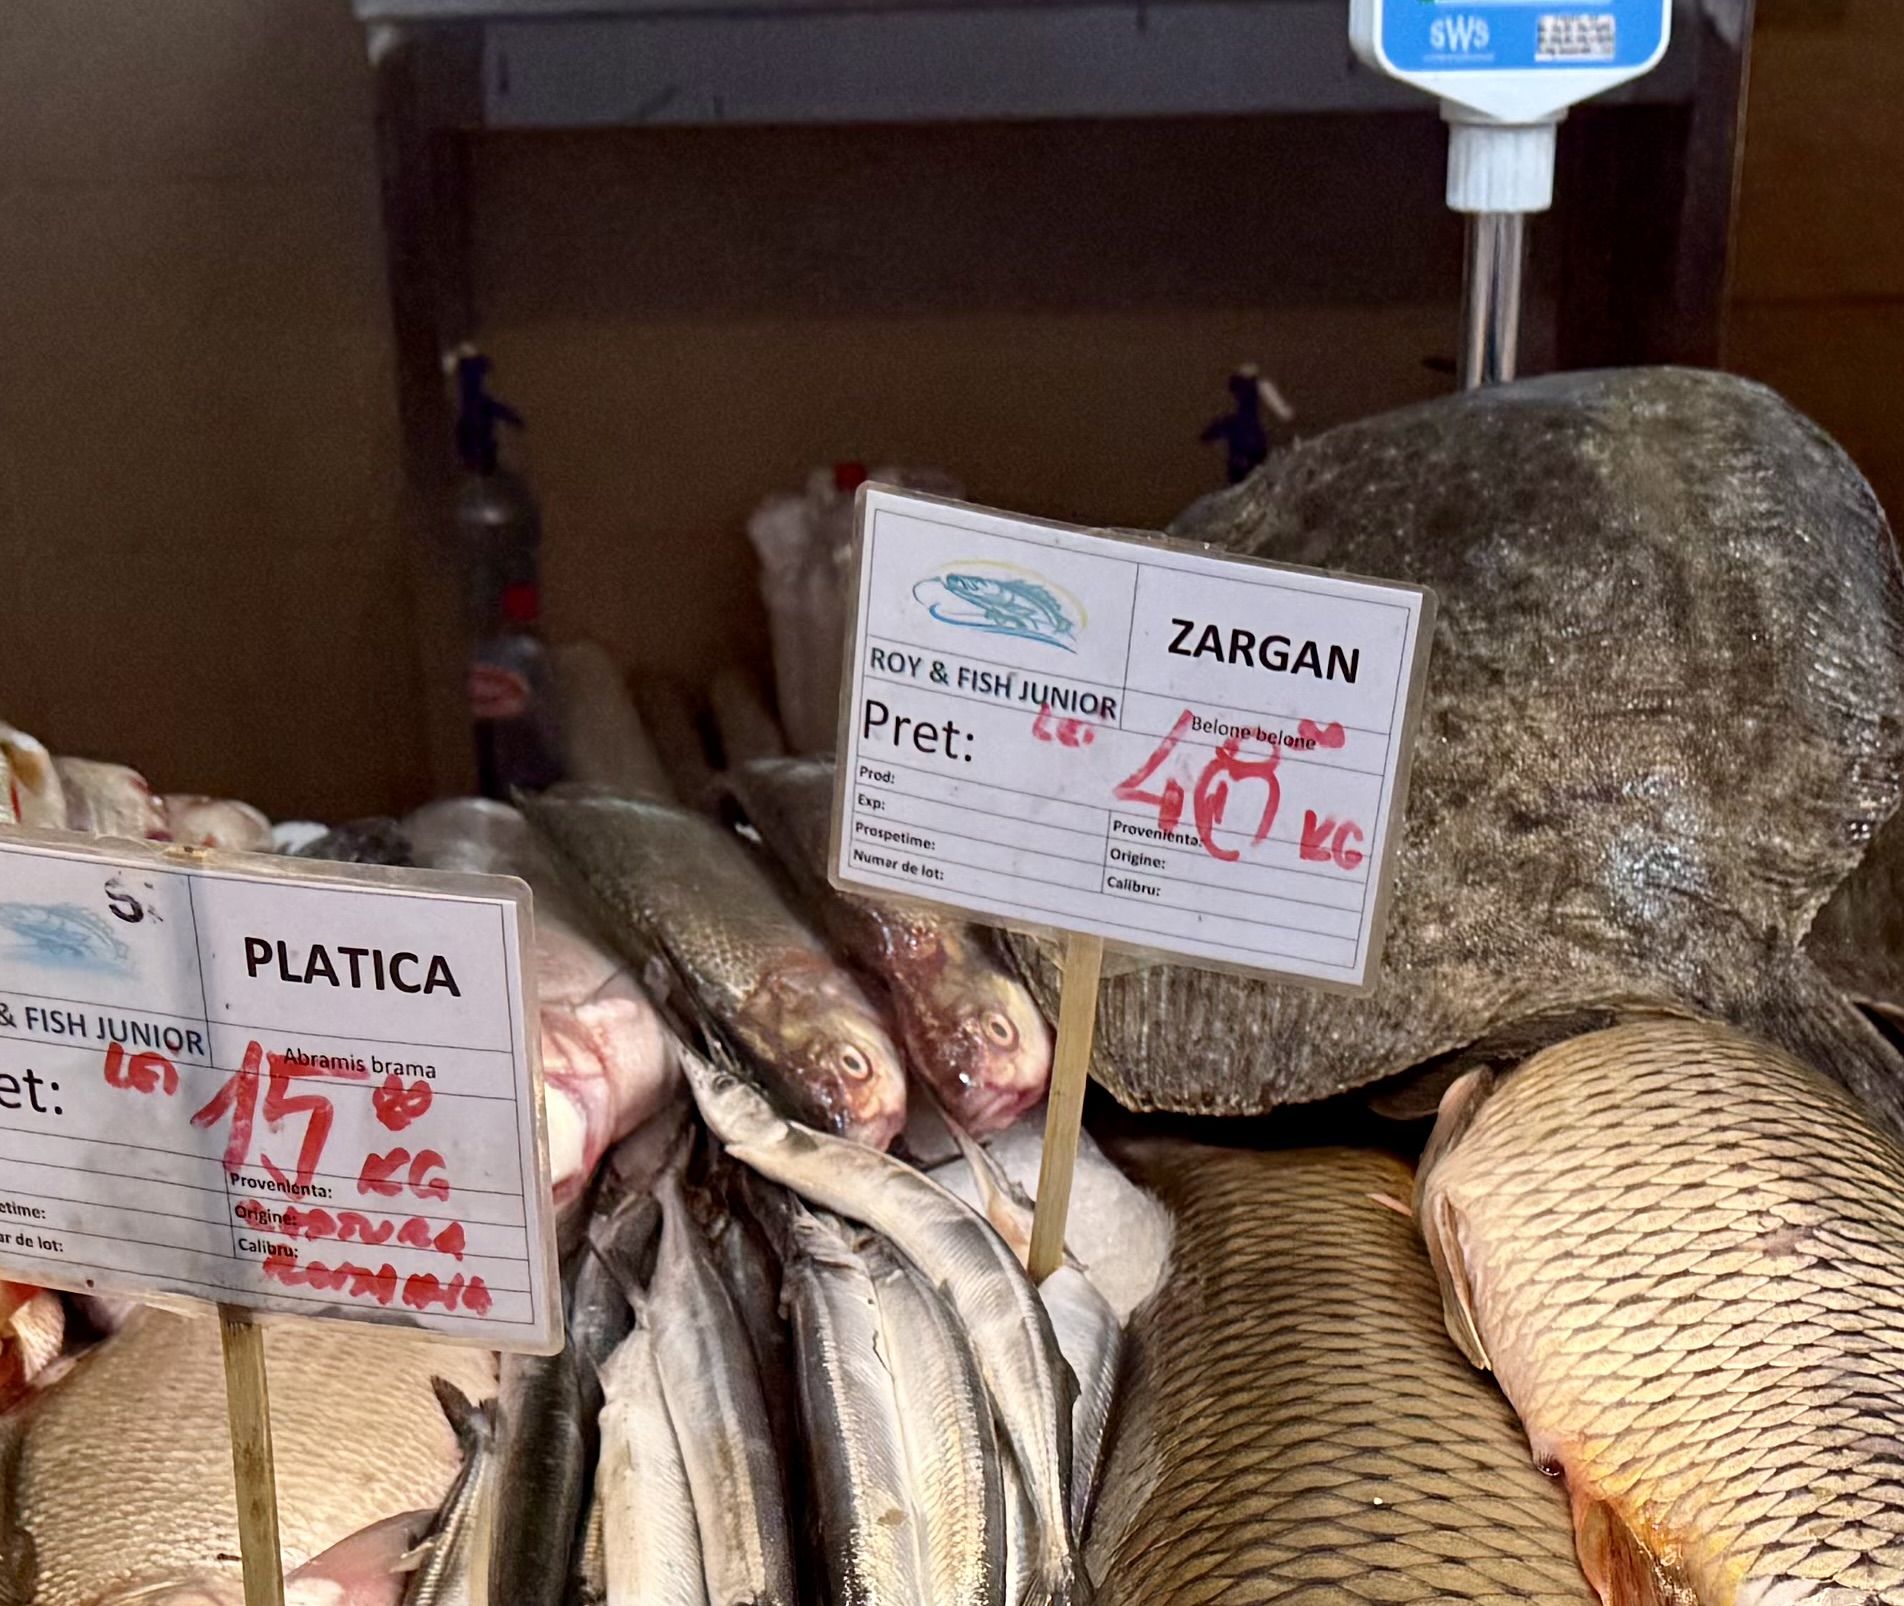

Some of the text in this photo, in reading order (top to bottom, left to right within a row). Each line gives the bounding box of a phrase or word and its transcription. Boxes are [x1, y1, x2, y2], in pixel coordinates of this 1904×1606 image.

[1168, 618, 1359, 684] ZARGAN
[870, 647, 1117, 720] ROY & FISH JUNIOR
[863, 699, 975, 763] Pret:
[1192, 716, 1316, 751] Belone belone
[860, 765, 895, 784] Prod:
[858, 793, 885, 811] Exp:
[856, 821, 935, 850] Prospetime:
[1300, 809, 1363, 870] KG
[853, 849, 944, 881] Numar de lot:
[1110, 848, 1166, 870] Origine:
[1107, 876, 1161, 897] Calibru:
[244, 936, 461, 997] PLATICA
[26, 1006, 86, 1038] FISH
[96, 1016, 205, 1055] JUNIOR
[283, 1048, 437, 1079] Abramis brama
[190, 1040, 371, 1201] 15
[231, 1172, 332, 1199] Provenienta:
[357, 1147, 450, 1202] KG
[235, 1204, 297, 1226] Origine:
[16, 1232, 34, 1248] de
[39, 1236, 64, 1252] lot:
[238, 1238, 299, 1258] Calibru:
